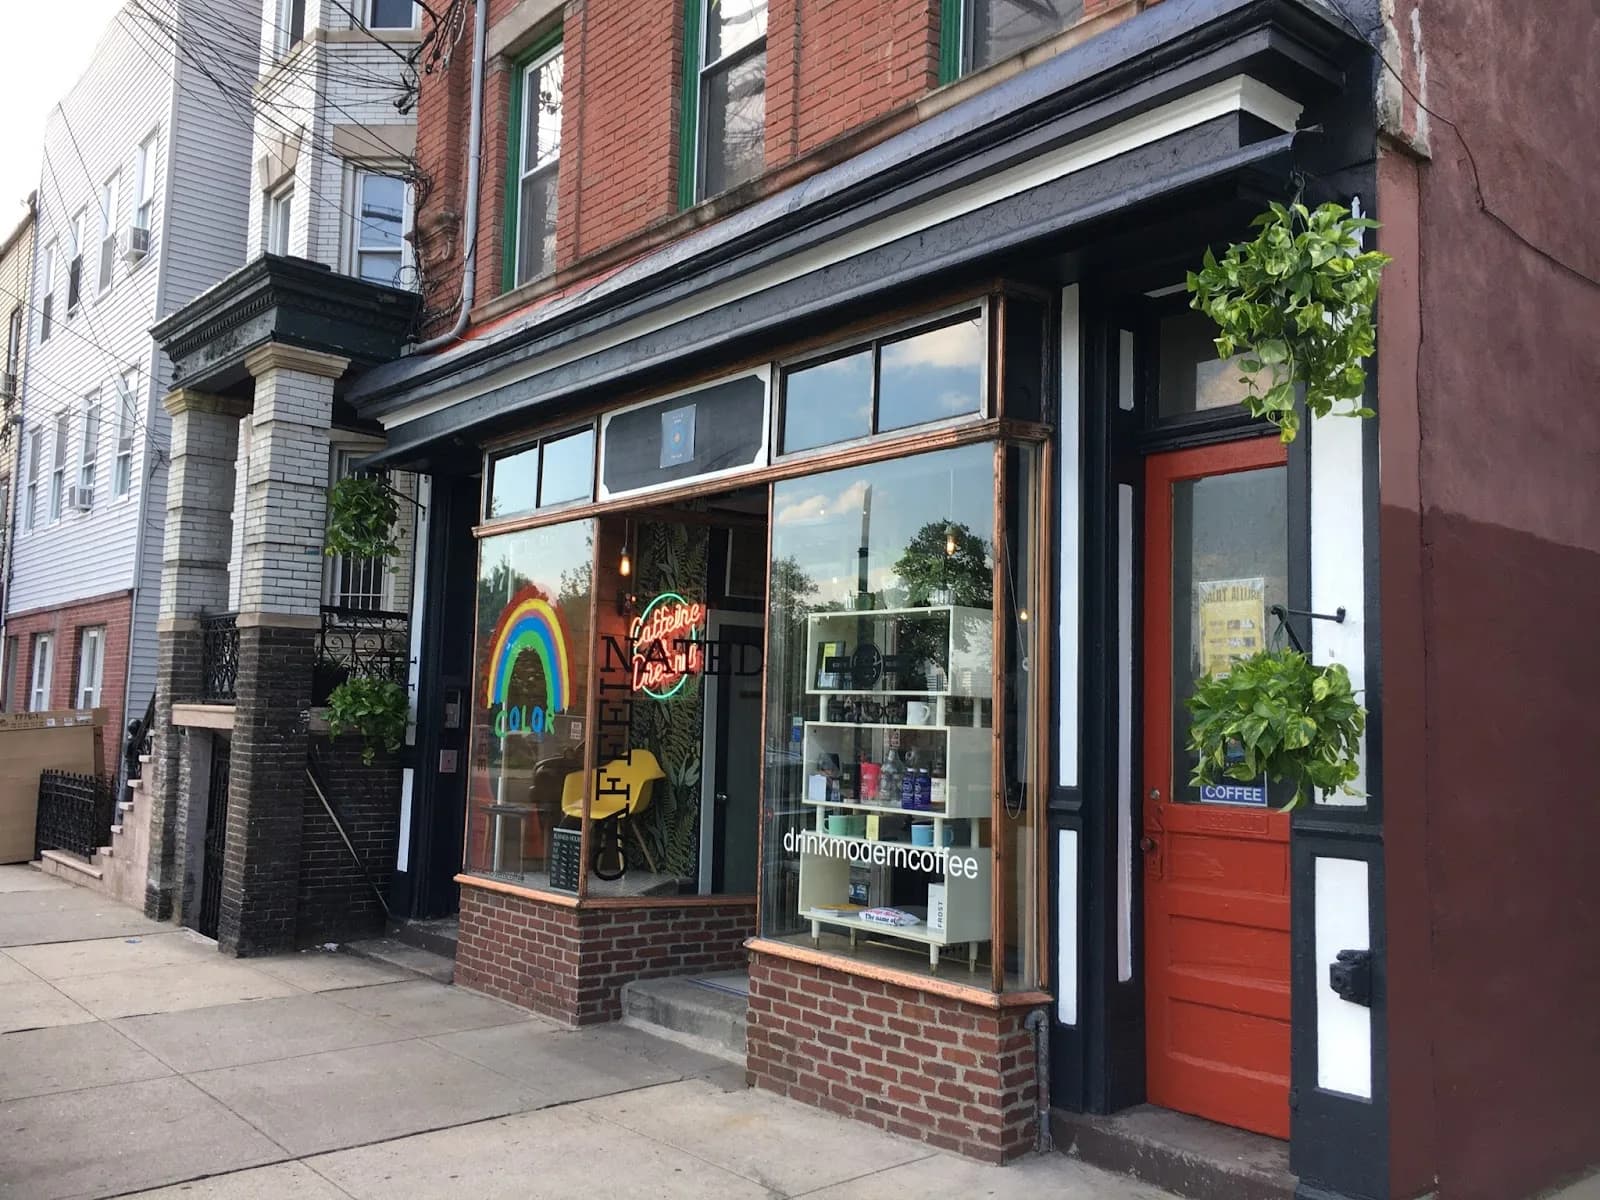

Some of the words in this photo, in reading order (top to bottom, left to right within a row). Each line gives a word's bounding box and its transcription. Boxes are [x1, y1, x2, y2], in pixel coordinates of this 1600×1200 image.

[630, 603, 701, 647] Caffeine
[495, 705, 555, 738] COLOR
[1205, 785, 1262, 802] COFFEE
[783, 827, 979, 879] drinkmoderncoffee
